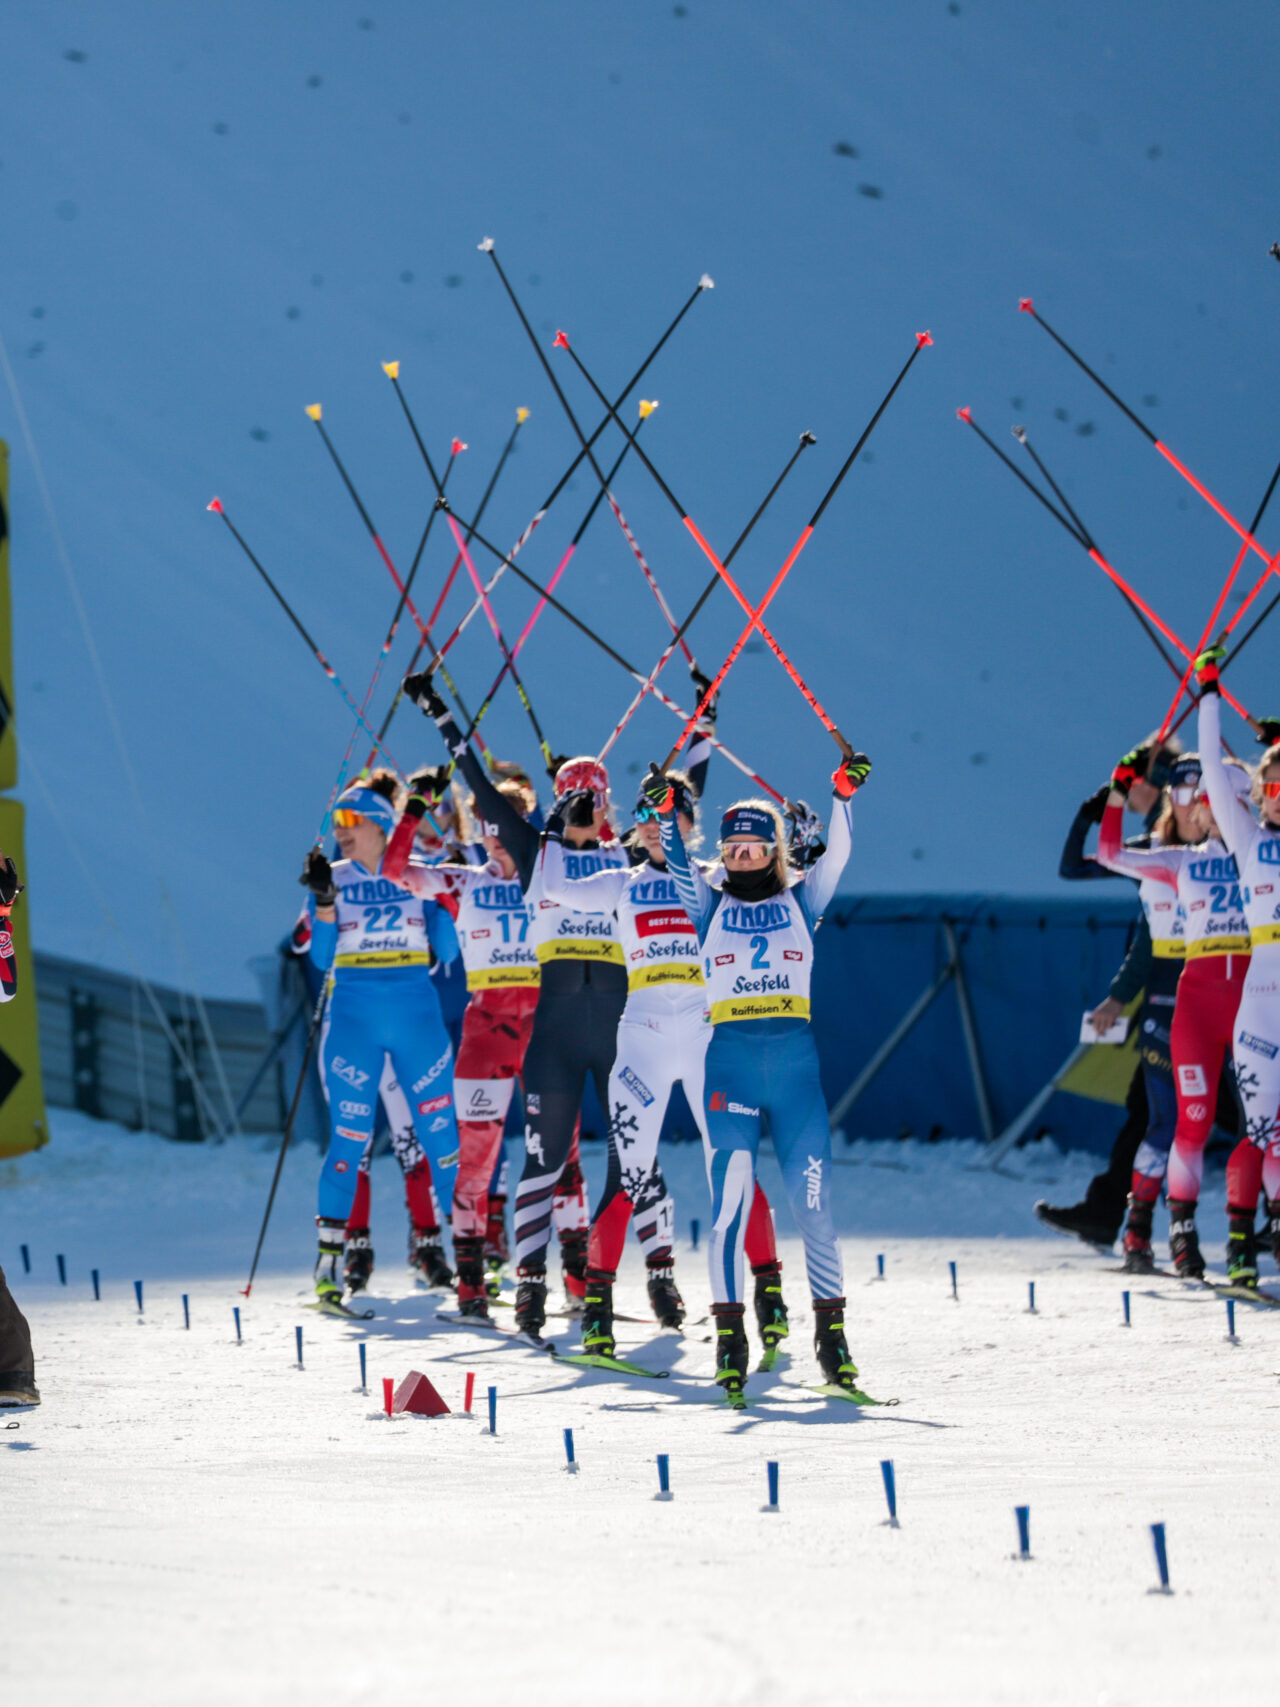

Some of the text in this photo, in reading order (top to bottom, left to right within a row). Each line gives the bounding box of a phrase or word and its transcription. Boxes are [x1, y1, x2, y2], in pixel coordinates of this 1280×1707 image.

[659, 821, 673, 851] FIN
[1189, 856, 1236, 880] TYRO
[472, 884, 524, 906] TYRO
[1210, 885, 1244, 913] 24
[363, 905, 403, 933] 22
[497, 913, 529, 943] 17
[557, 919, 612, 936] Seefeld
[722, 903, 791, 931] TYROLIT
[1205, 918, 1249, 935] Seefel
[646, 940, 699, 959] Seefeld
[750, 935, 770, 970] 2
[732, 974, 790, 994] Seefeld
[731, 1005, 779, 1016] Raiffeisen
[331, 1056, 369, 1088] EA7
[728, 1102, 759, 1117] Sievi
[803, 1155, 822, 1211] swix
